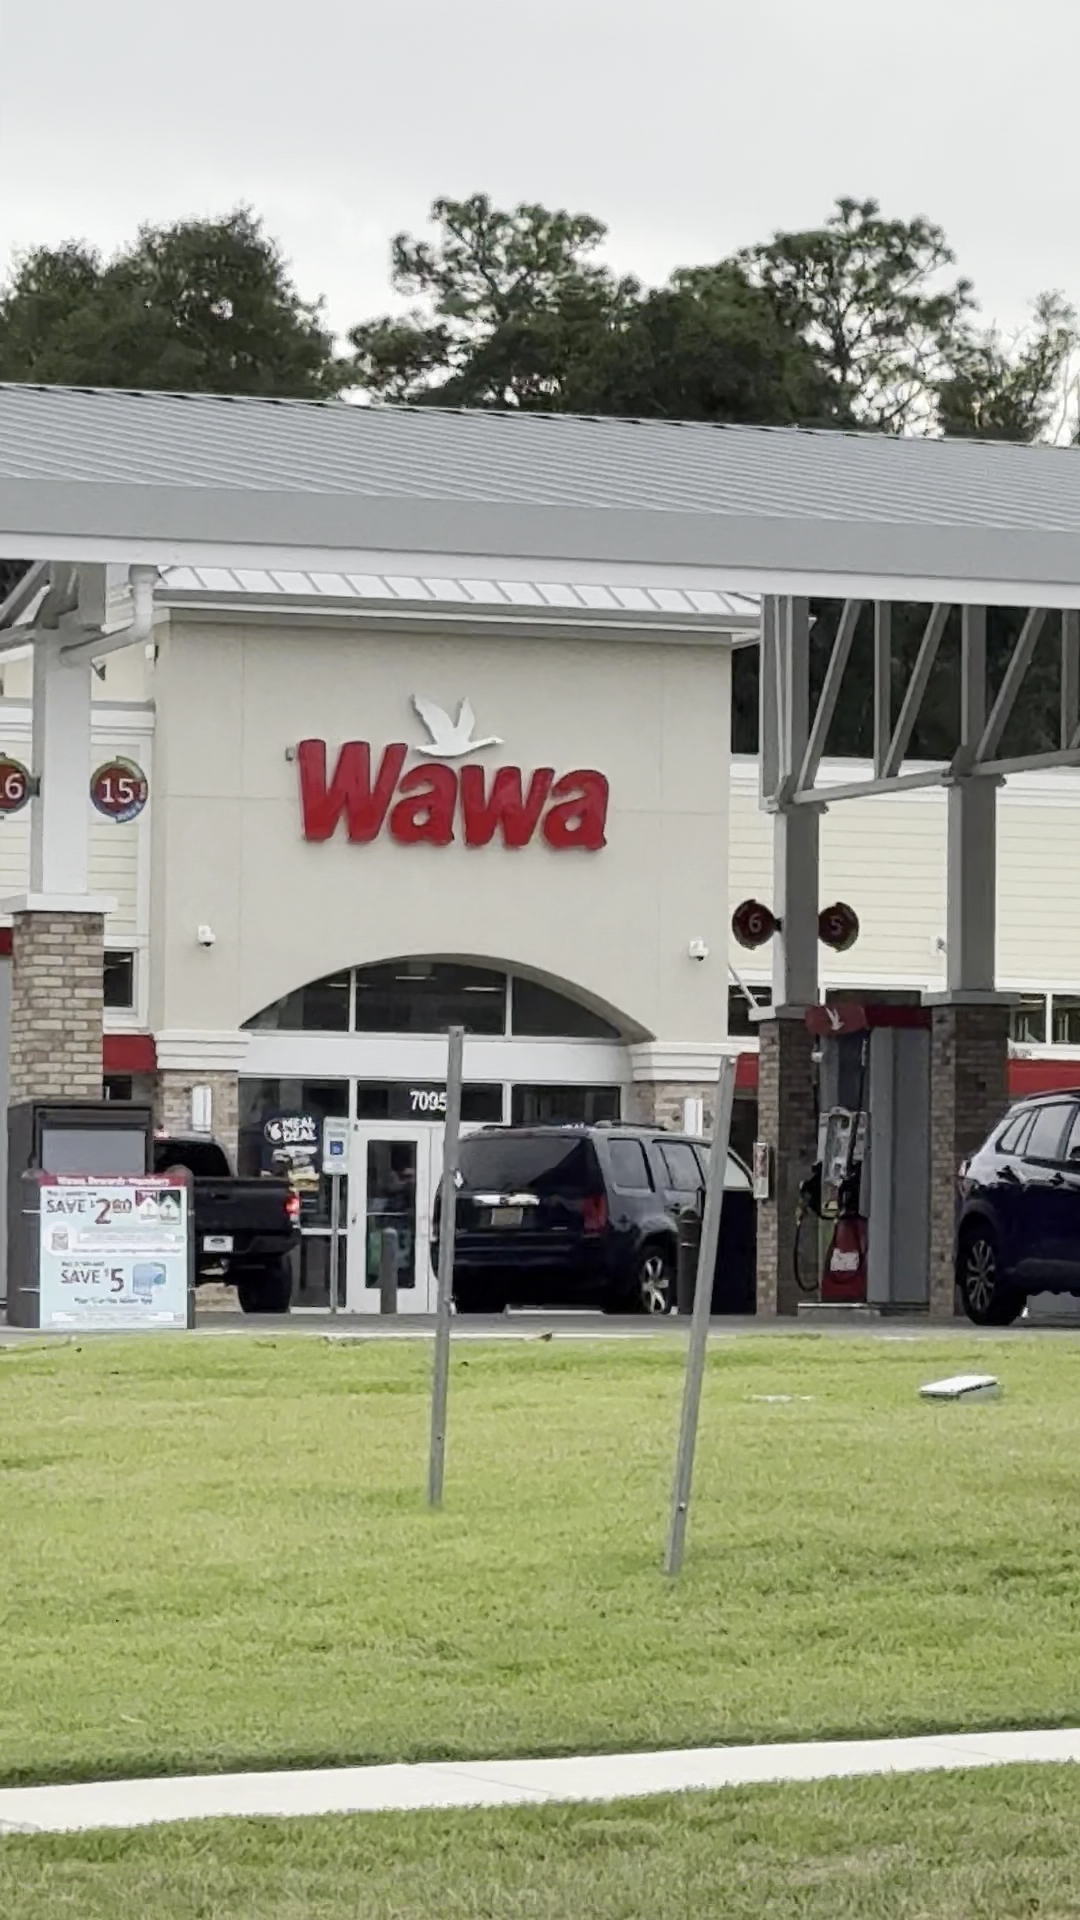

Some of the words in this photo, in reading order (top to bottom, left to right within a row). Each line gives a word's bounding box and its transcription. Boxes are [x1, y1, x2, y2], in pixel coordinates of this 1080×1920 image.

[0, 773, 23, 799] 6
[99, 777, 134, 804] 15
[299, 738, 608, 850] Wawa
[748, 913, 763, 934] 6
[829, 914, 843, 935] 5
[409, 1090, 447, 1111] 7095
[46, 1199, 87, 1213] SAVE
[60, 1269, 101, 1284] SAVE
